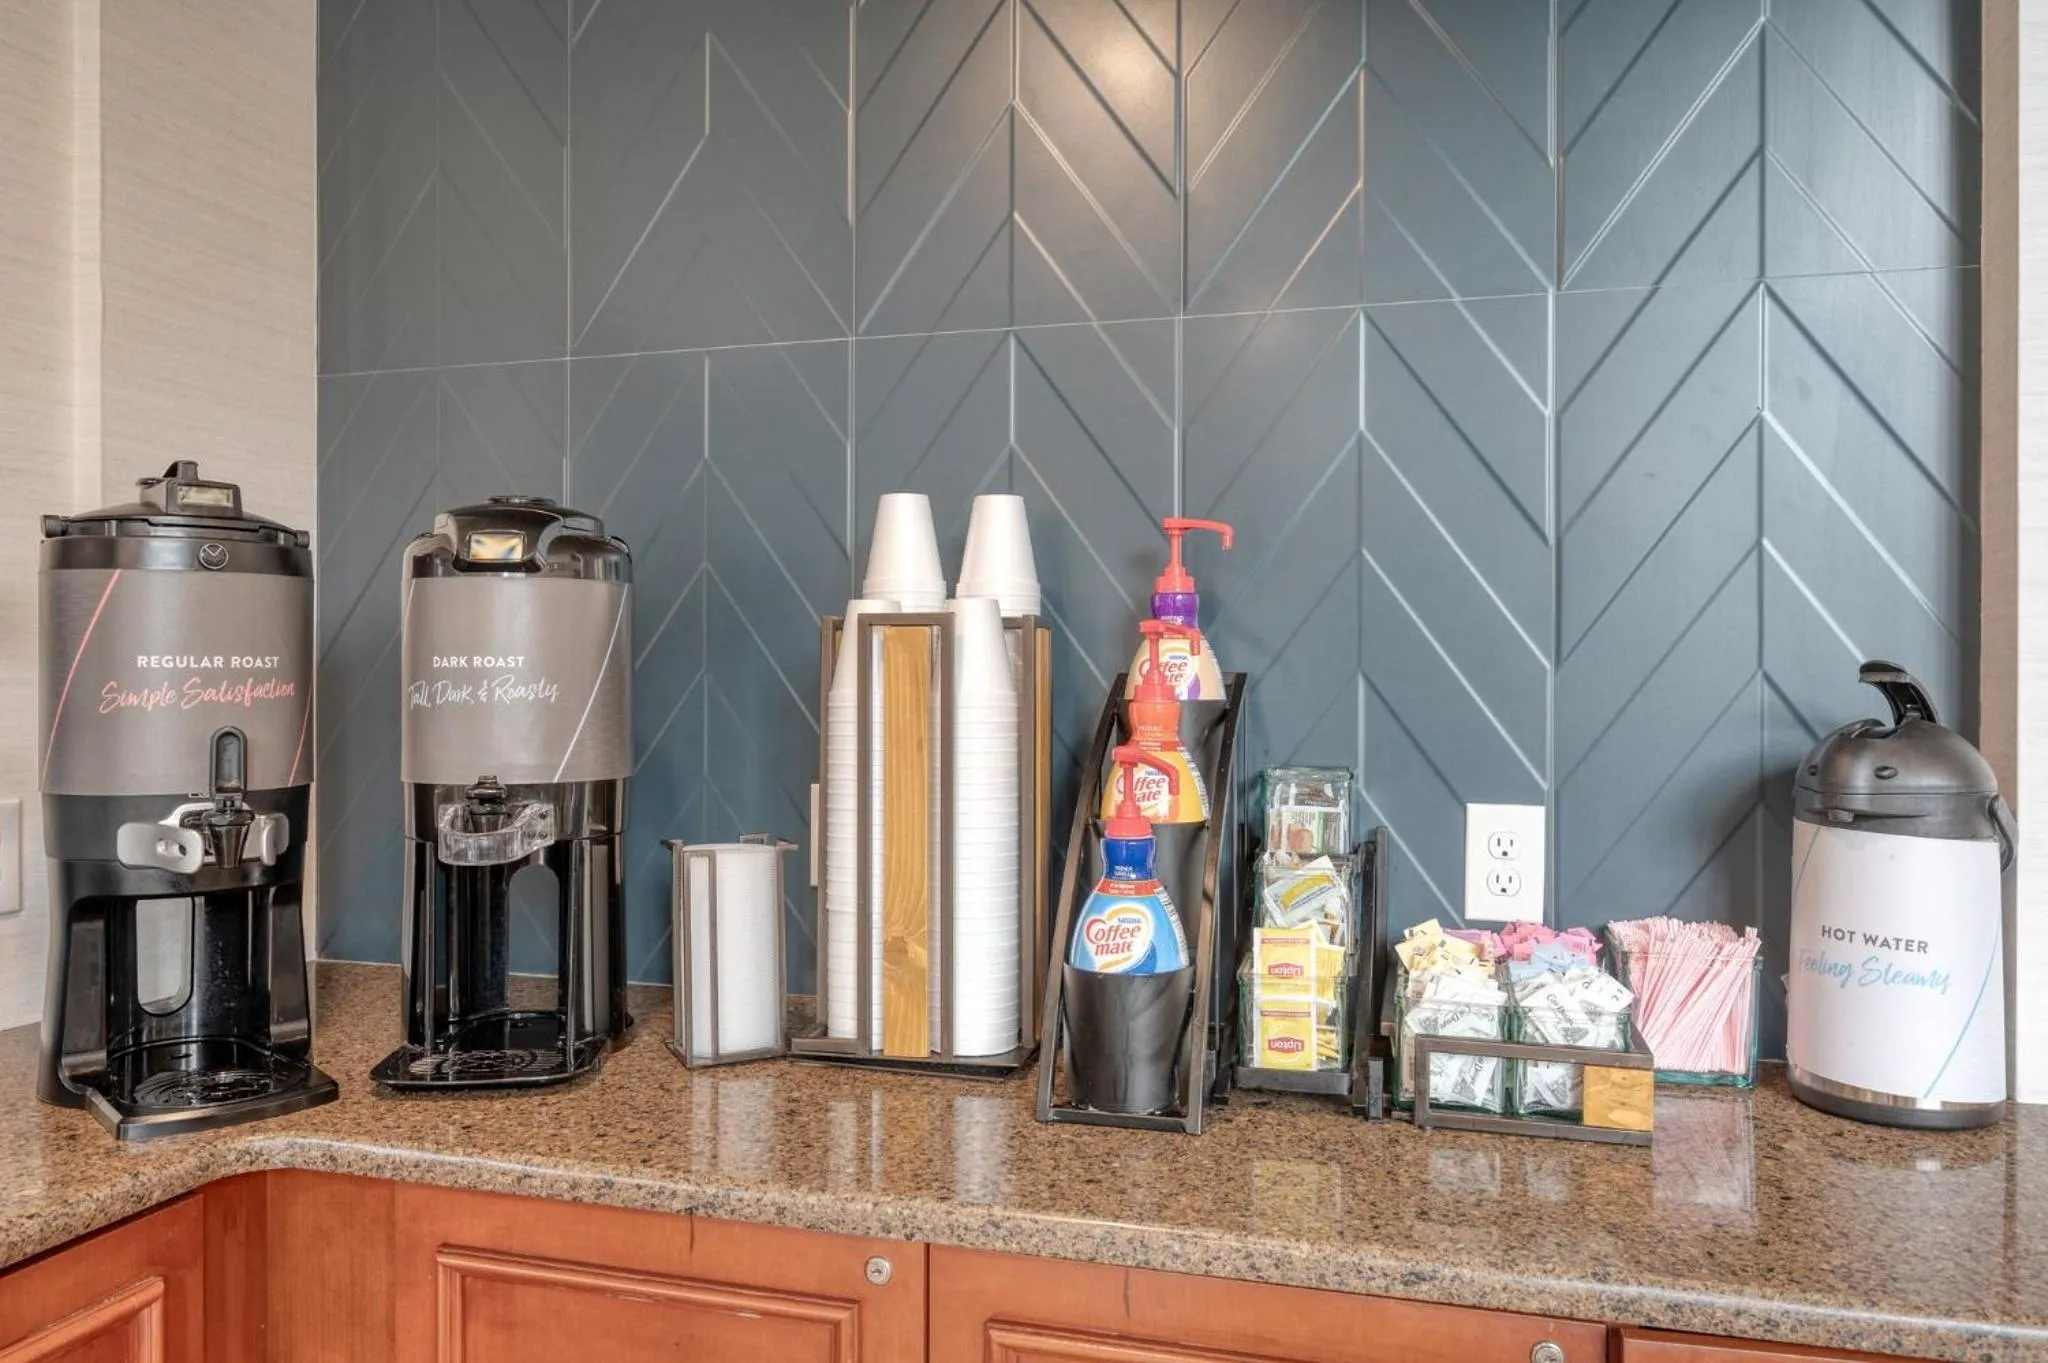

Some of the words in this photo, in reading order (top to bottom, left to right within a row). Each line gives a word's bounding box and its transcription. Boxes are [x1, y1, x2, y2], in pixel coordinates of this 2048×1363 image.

[137, 655, 224, 669] REGULAR
[230, 655, 280, 669] ROAST
[432, 656, 468, 668] DARK
[473, 656, 525, 668] ROAST
[99, 680, 176, 714] Simple
[180, 676, 295, 709] Satisfaction
[491, 674, 560, 705] Roasty
[1134, 790, 1161, 803] ate
[1085, 918, 1141, 945] Coffee
[1821, 925, 1856, 944] HOT
[1863, 932, 1929, 954] WATER
[1094, 940, 1134, 956] mate
[1270, 965, 1301, 977] Lipton
[1798, 948, 1853, 989] Feeling
[1858, 955, 1952, 995] Steamy
[1270, 1039, 1302, 1051] Lipton
